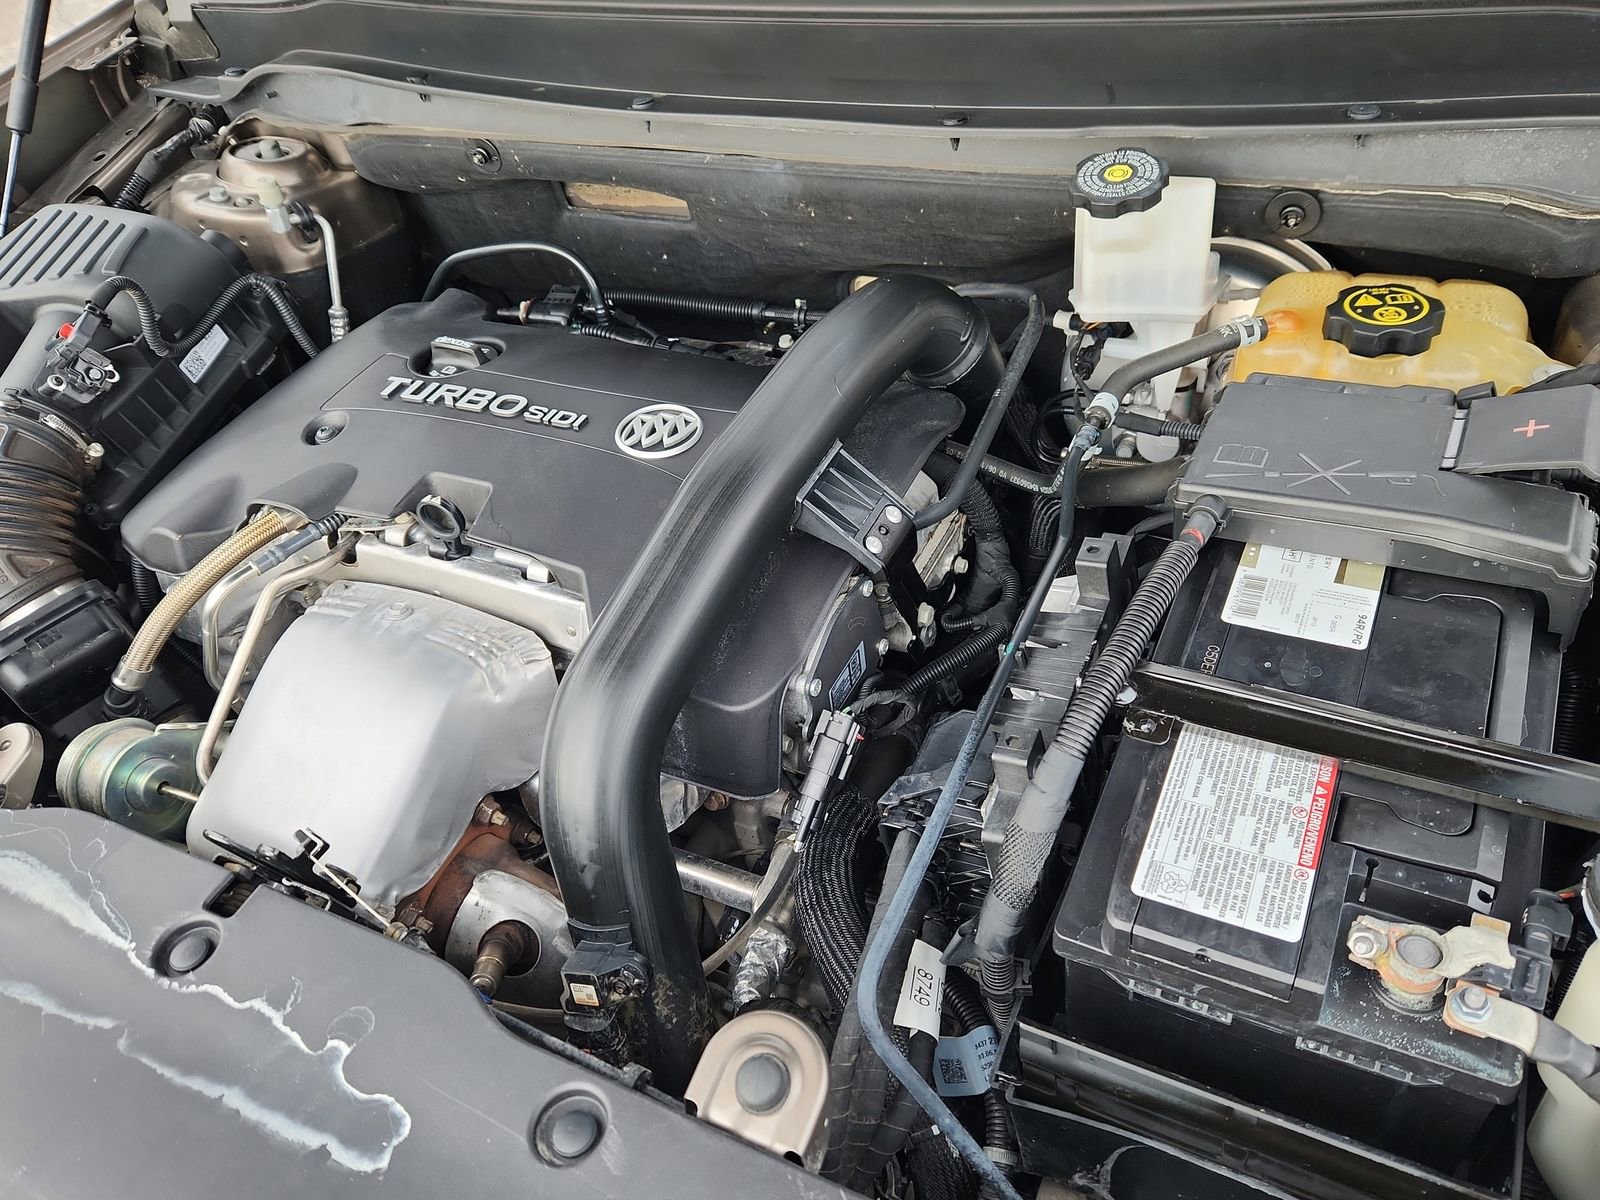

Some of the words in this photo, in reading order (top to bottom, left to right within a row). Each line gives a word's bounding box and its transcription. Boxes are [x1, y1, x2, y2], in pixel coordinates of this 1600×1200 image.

[379, 376, 528, 418] TURBO
[523, 405, 589, 431] SIDI
[1322, 557, 1332, 569] ERY
[1350, 613, 1367, 645] 94R/PG
[1277, 764, 1285, 774] LOS
[1284, 759, 1294, 779] BLESSER
[1264, 773, 1274, 792] CAUSAR
[1282, 778, 1289, 786] OU
[1305, 766, 1316, 793] EXPLOSIVE
[1288, 787, 1296, 797] LES
[1294, 775, 1306, 802] BLINDNESS
[1260, 795, 1268, 804] NO
[1276, 799, 1285, 810] PAS
[1297, 820, 1305, 829] NO
[1299, 796, 1325, 866] PELIGRO/VENENO
[1229, 900, 1237, 912] PAS
[1278, 896, 1286, 904] DE
[1255, 912, 1264, 923] LOS
[913, 968, 934, 1007] 8749
